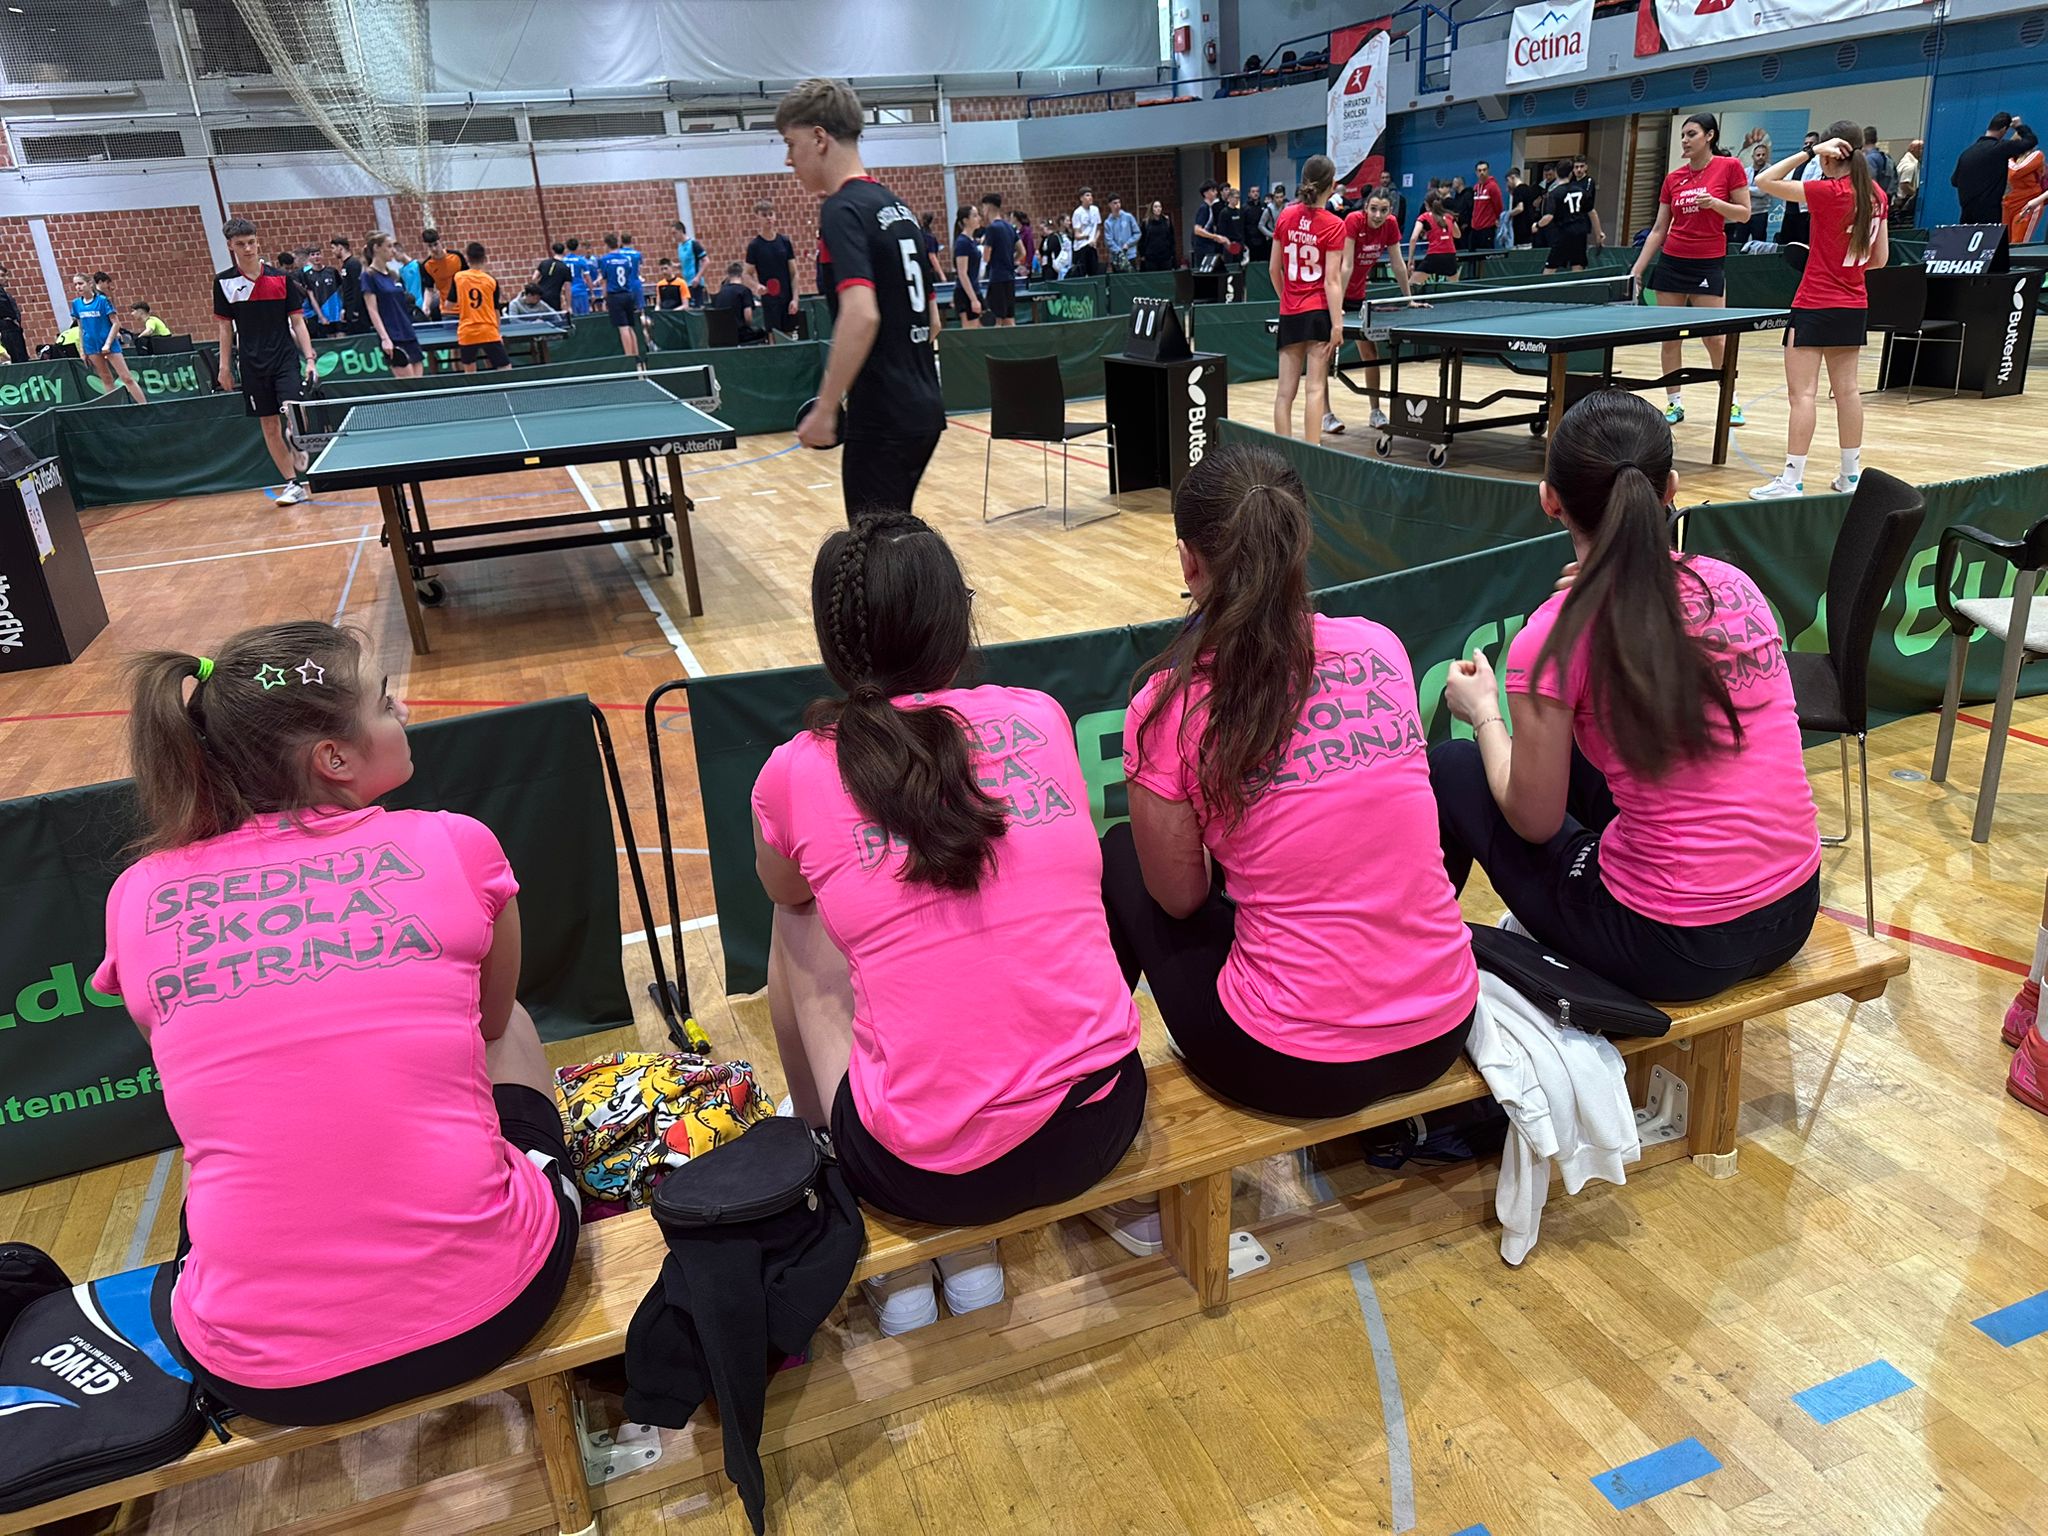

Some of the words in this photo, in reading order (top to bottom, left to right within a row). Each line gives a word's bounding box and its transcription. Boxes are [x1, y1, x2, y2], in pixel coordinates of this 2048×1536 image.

[1514, 32, 1581, 67] Cetina
[1564, 192, 1582, 213] 17
[1287, 229, 1318, 245] VICTORIA
[1968, 231, 1983, 252] 0
[1284, 242, 1323, 282] 13
[1925, 260, 1985, 274] TIBHAR
[616, 266, 626, 287] 8
[898, 239, 926, 313] 5
[469, 288, 482, 309] 9
[1520, 341, 1547, 354] Butterfly
[1997, 311, 2022, 382] Butterfly
[0, 375, 63, 405] erfly
[673, 438, 723, 454] Butterfly
[1701, 615, 1766, 652] OLA
[156, 850, 412, 924] SREDNJA
[186, 890, 388, 957] ŠKOLA
[155, 922, 433, 1016] PETRINJA
[69, 1335, 84, 1347] PLAY
[88, 1347, 104, 1358] WAY
[100, 1355, 123, 1372] BETTER
[119, 1368, 133, 1383] THE
